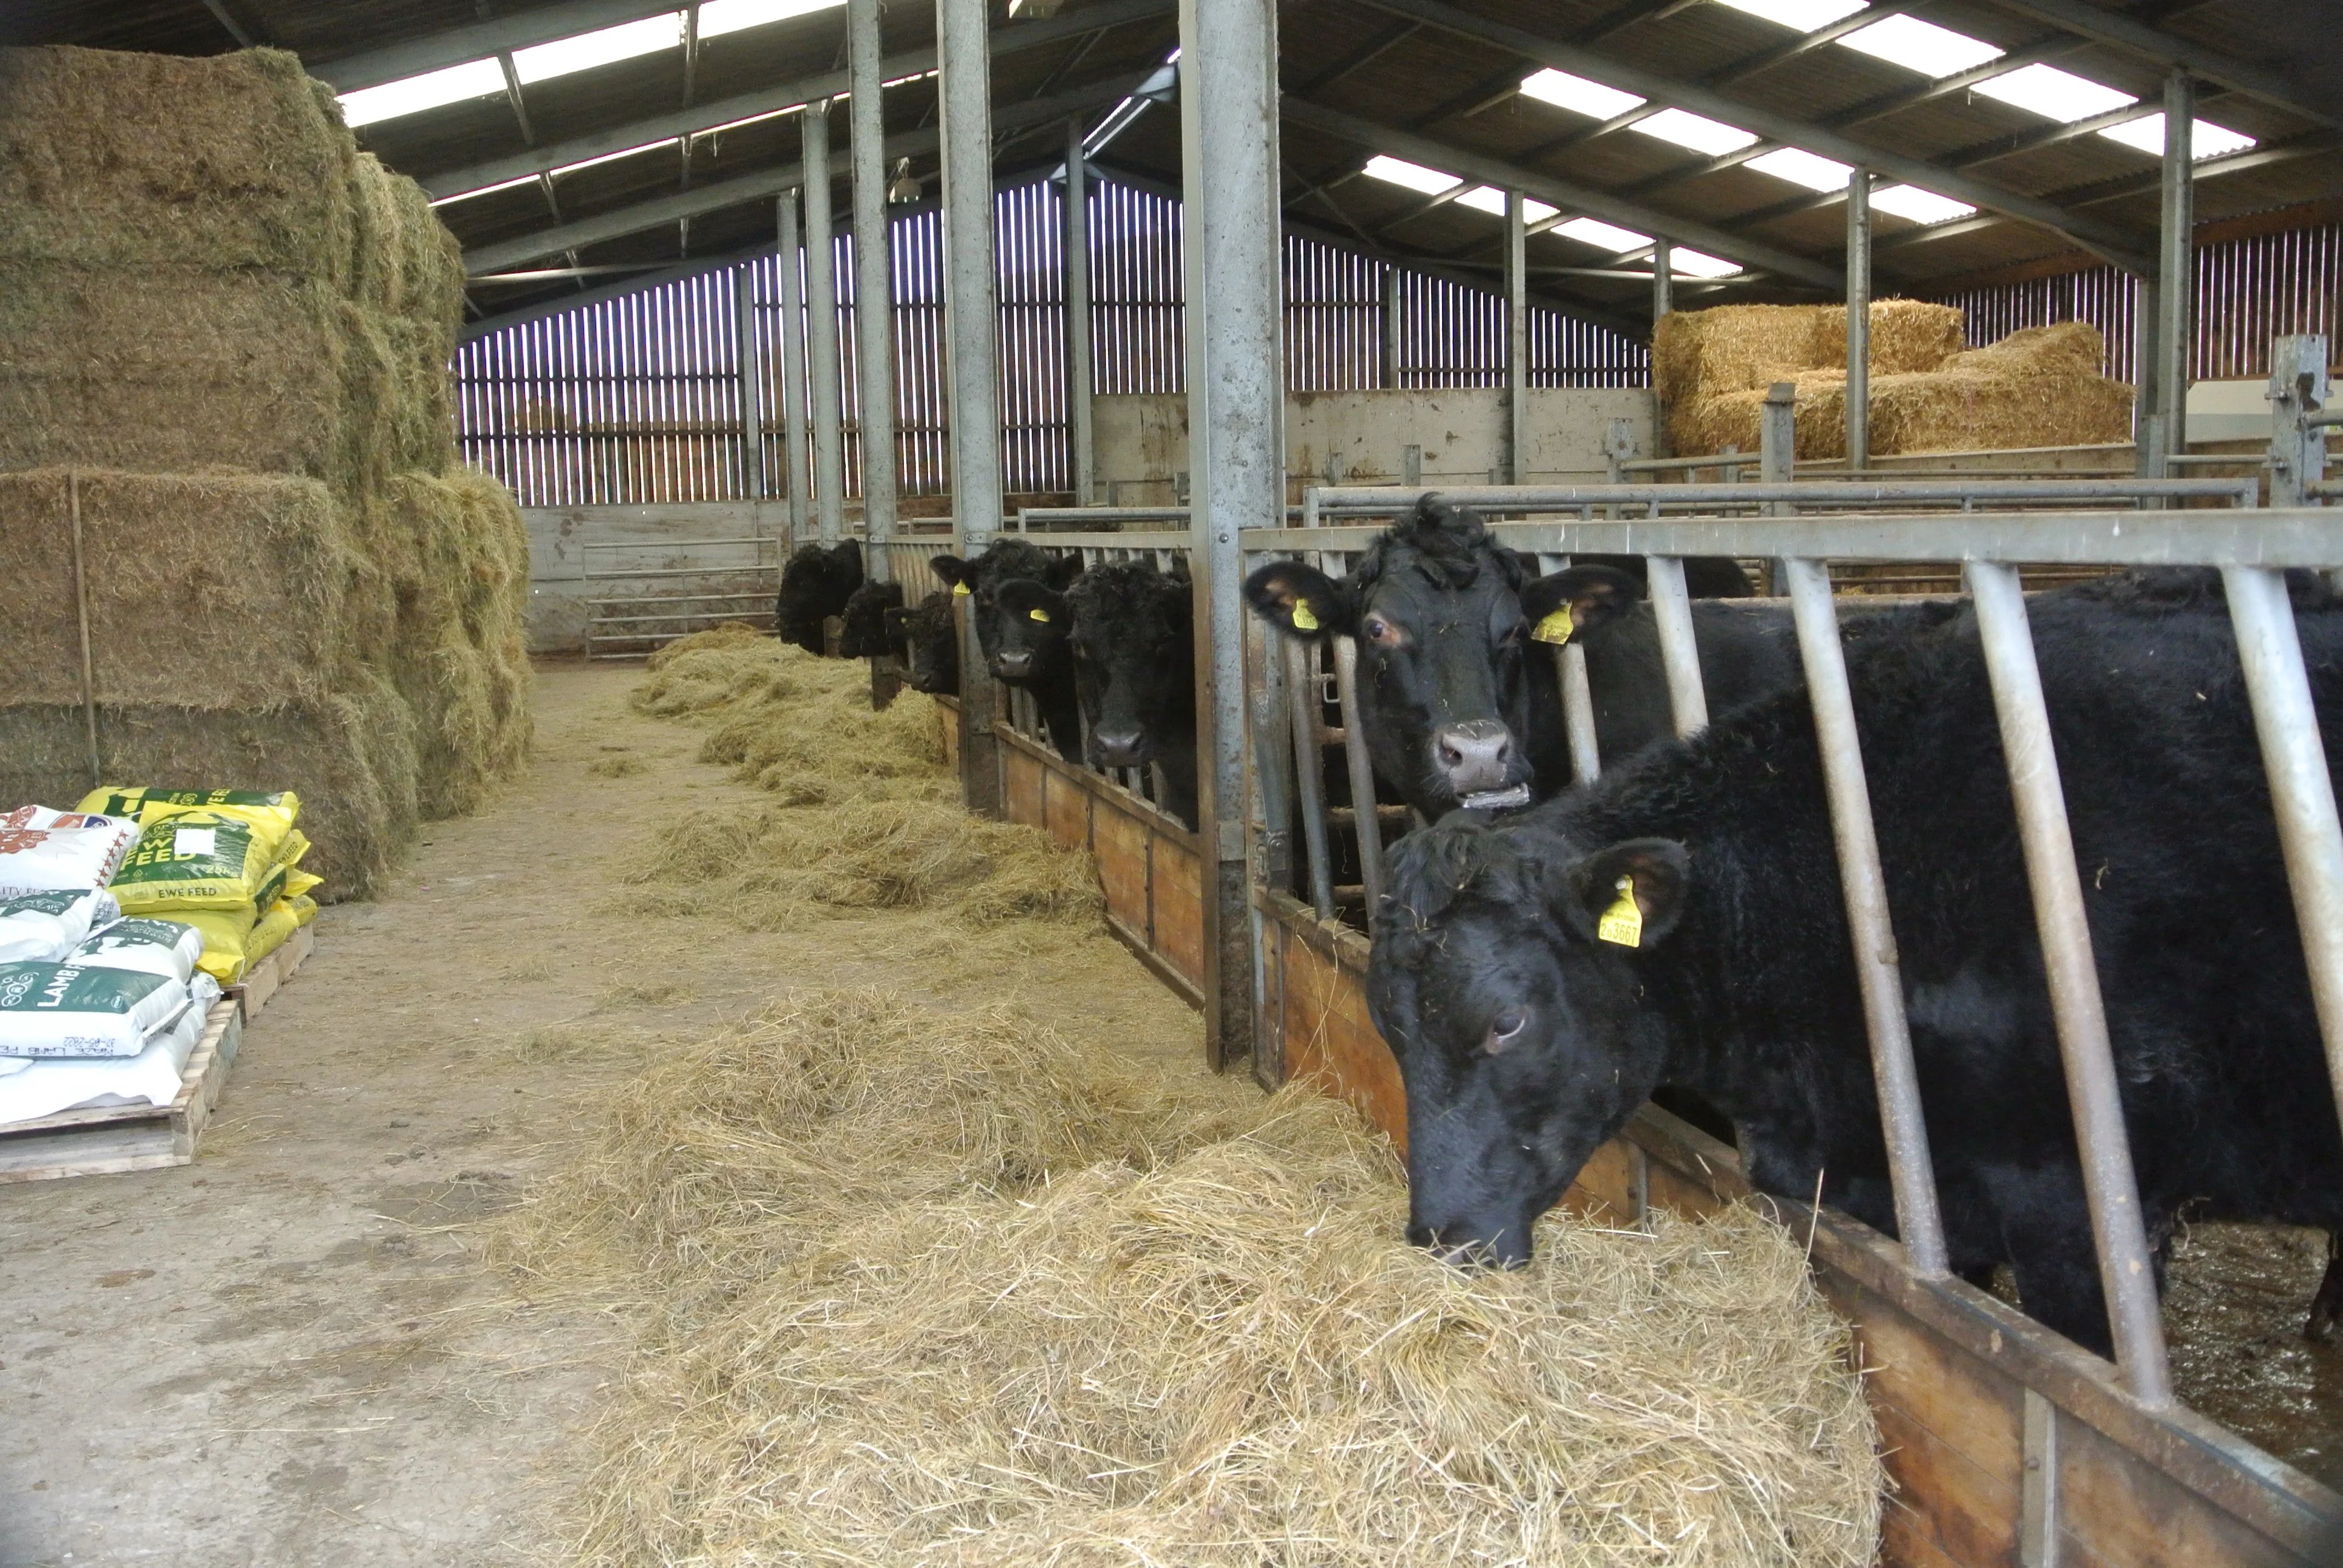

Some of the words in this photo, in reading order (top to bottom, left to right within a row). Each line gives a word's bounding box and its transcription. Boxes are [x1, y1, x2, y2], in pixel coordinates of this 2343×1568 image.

[159, 888, 184, 898] EWE
[188, 887, 217, 897] FEED
[37, 969, 80, 1007] LAMB
